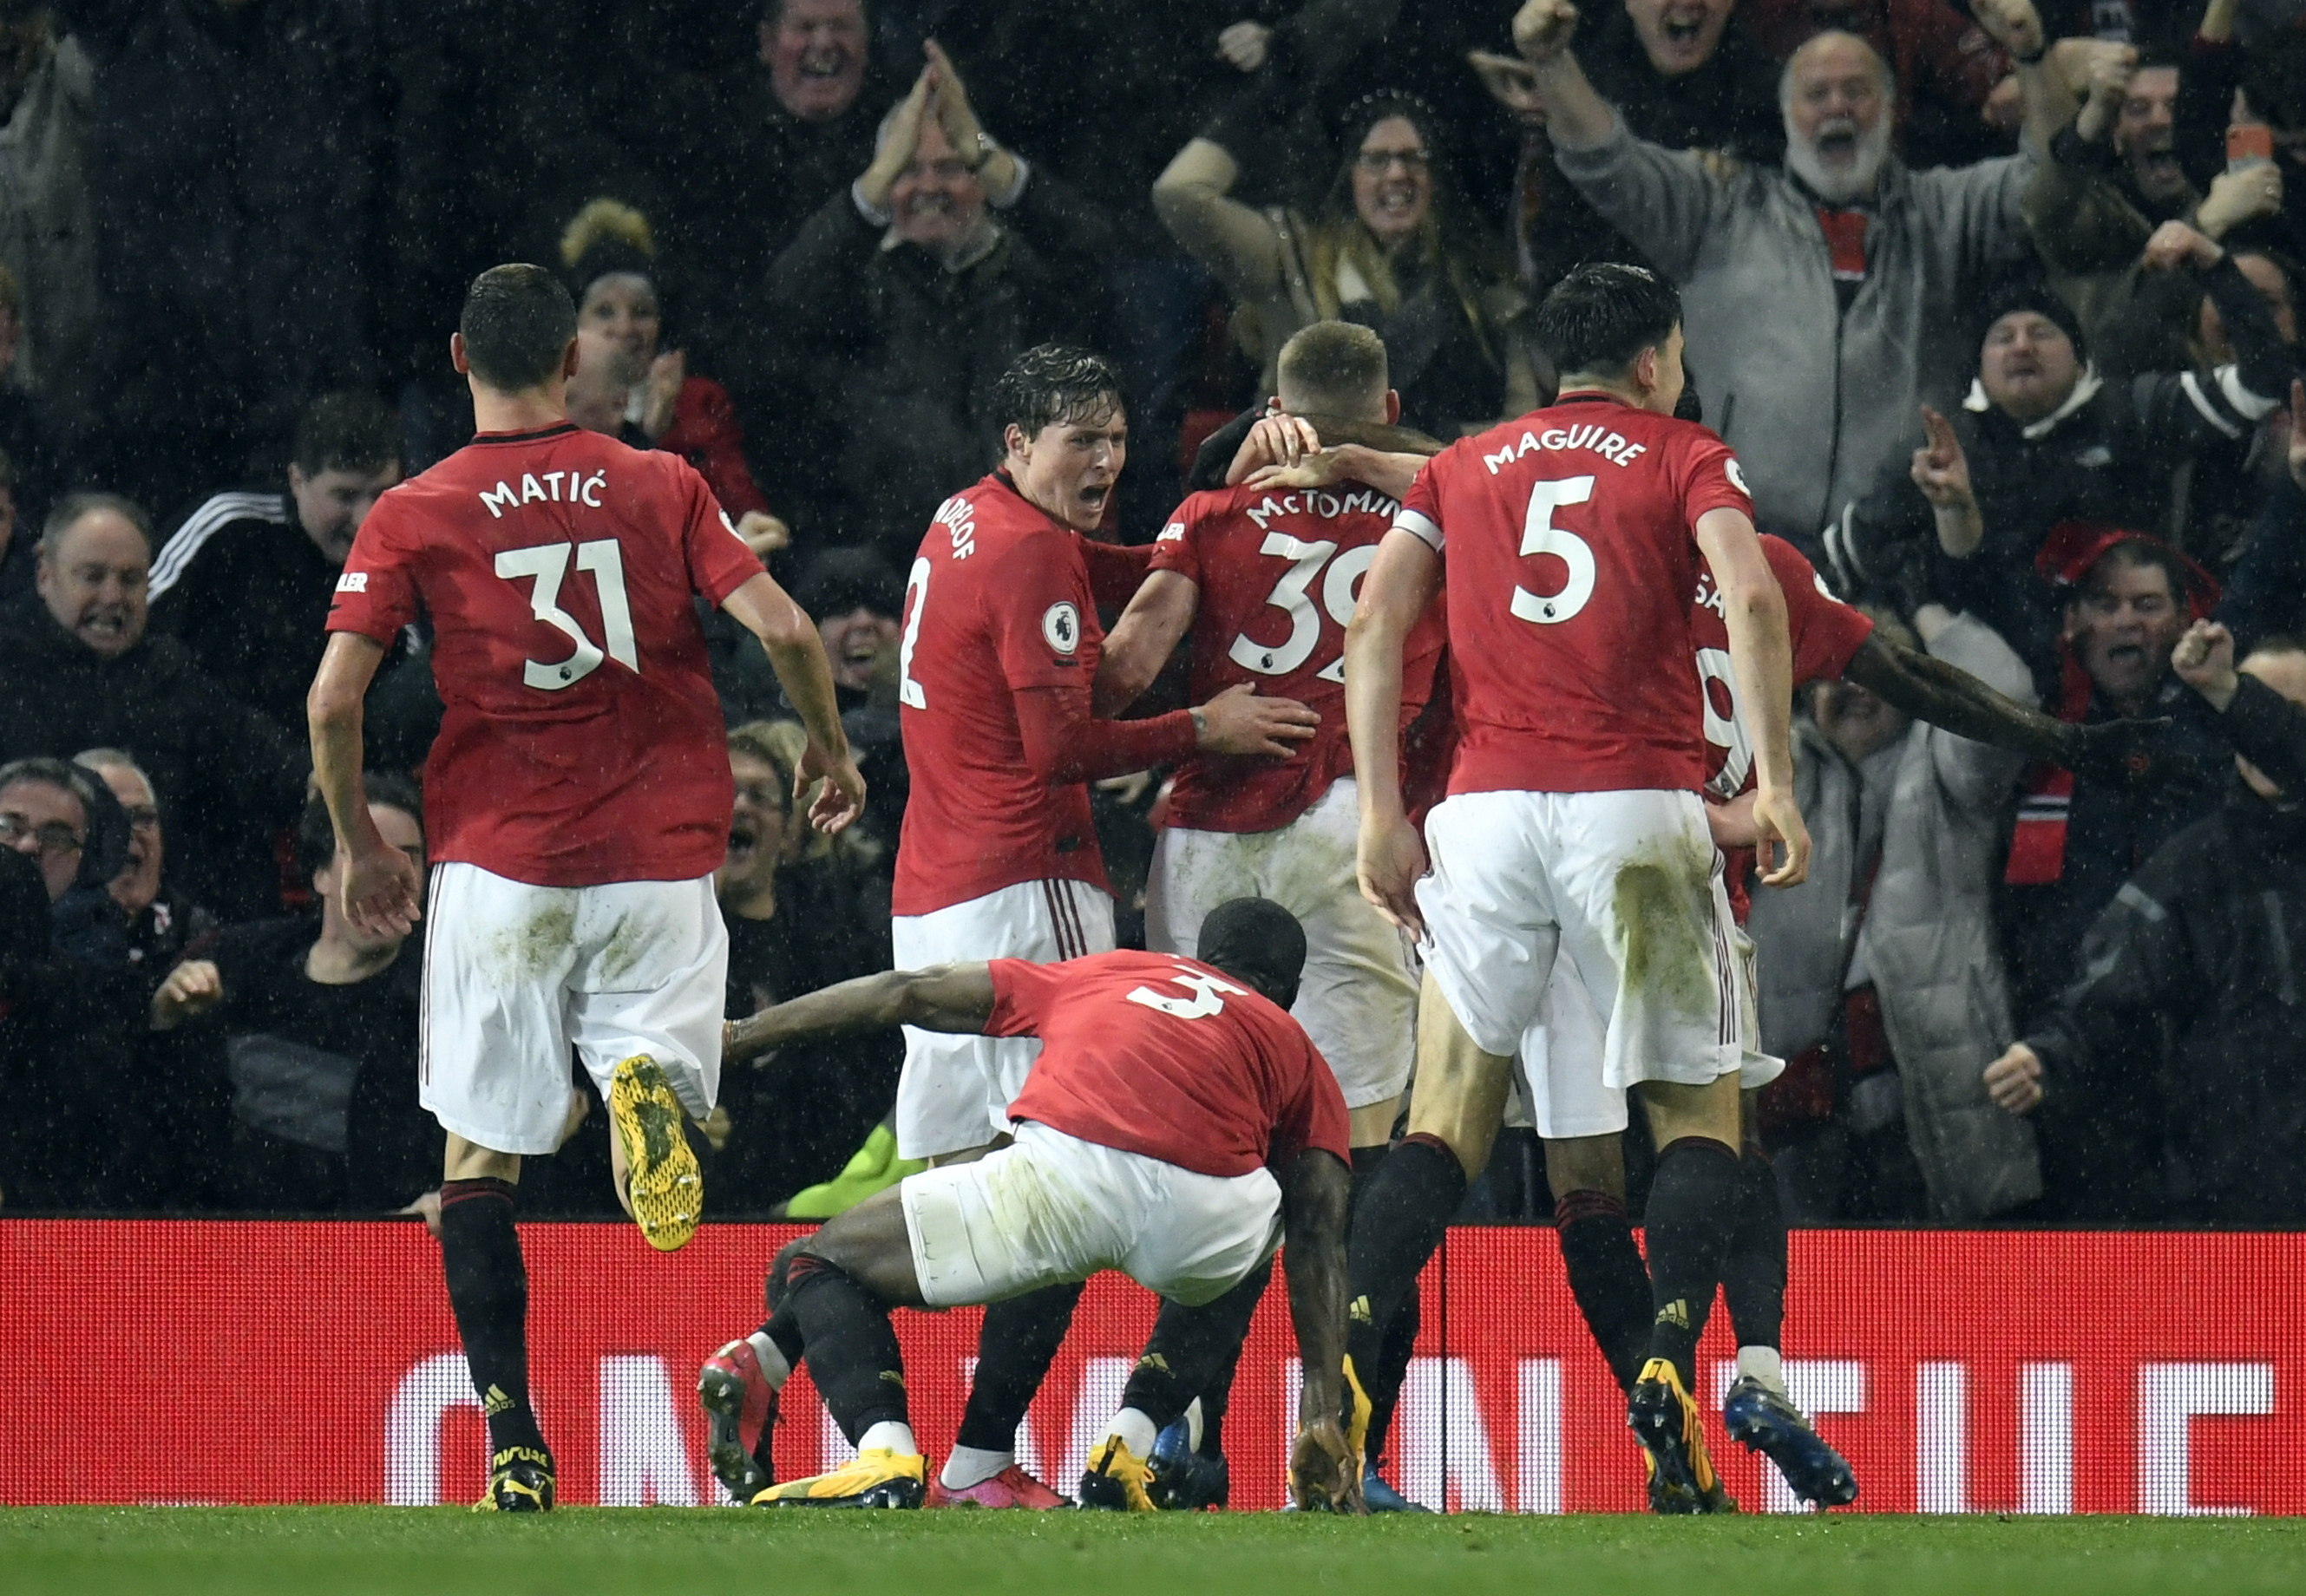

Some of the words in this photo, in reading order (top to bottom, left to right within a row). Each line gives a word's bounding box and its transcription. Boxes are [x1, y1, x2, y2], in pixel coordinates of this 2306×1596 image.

[478, 468, 607, 520] MATIĆ
[1483, 423, 1647, 474] MAGUIRE
[1510, 474, 1596, 625] 5
[494, 538, 641, 690] 31
